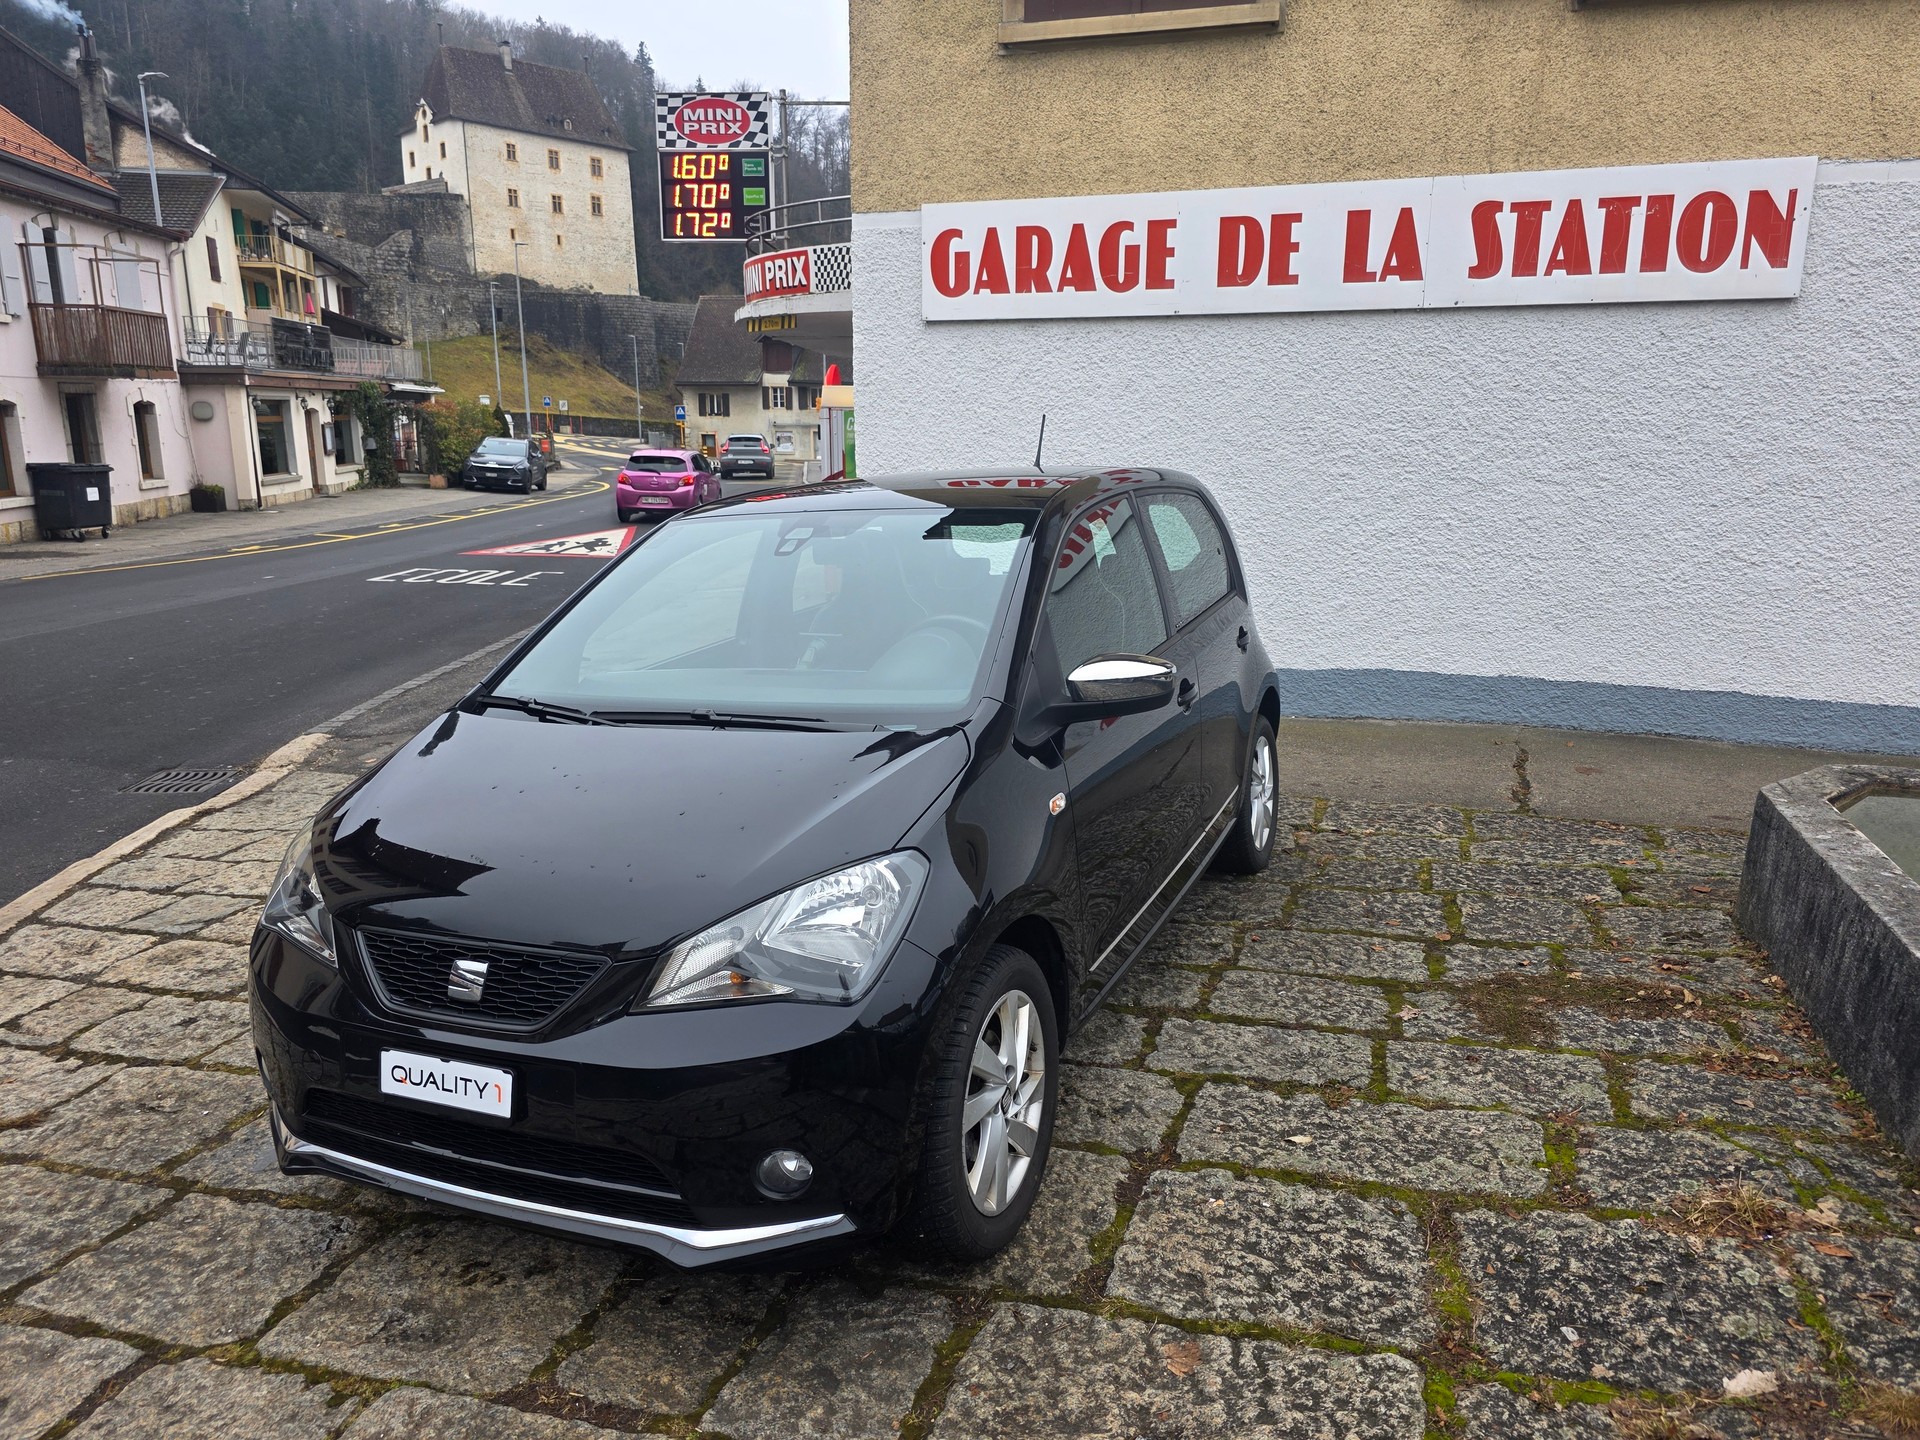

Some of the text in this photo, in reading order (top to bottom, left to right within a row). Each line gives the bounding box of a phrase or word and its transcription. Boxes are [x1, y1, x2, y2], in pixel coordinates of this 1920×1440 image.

[682, 108, 742, 121] MINI
[683, 122, 743, 135] PRIX
[931, 188, 1798, 297] GARAGE DE LA STATION
[764, 255, 808, 291] PRIX
[366, 568, 565, 587] ECOLE
[391, 1065, 502, 1103] QUALITY 1
